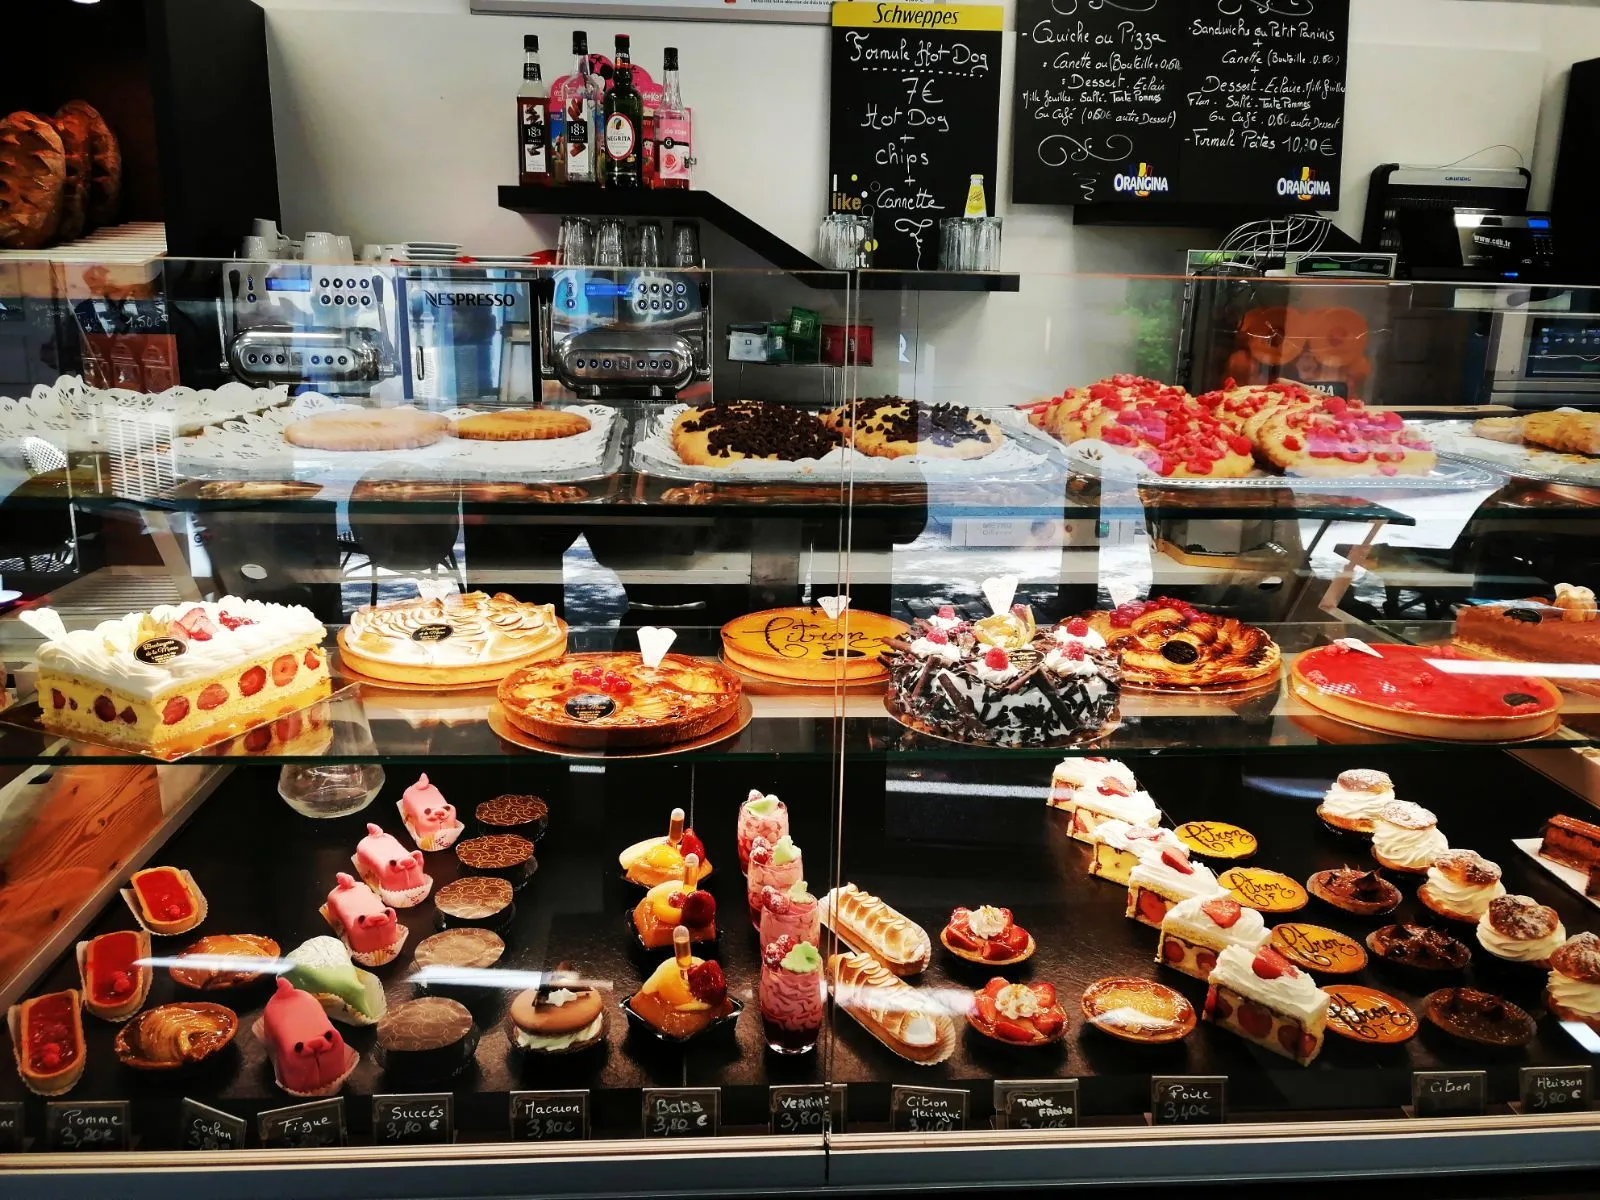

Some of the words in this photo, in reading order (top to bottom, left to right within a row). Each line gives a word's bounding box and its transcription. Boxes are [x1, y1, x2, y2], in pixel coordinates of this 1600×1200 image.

[873, 2, 959, 27] Schweppes
[1033, 19, 1089, 43] Quiche
[1095, 34, 1113, 44] ou
[1117, 21, 1166, 50] Pizza
[1268, 21, 1297, 37] Petit
[1298, 22, 1335, 42] Paninis
[845, 31, 910, 62] Formule
[914, 40, 950, 67] Hot
[951, 43, 989, 71] Dog
[861, 102, 903, 130] Hot
[907, 108, 949, 132] Dog
[1052, 107, 1077, 125] Café
[1192, 128, 1236, 147] Formule
[1114, 173, 1168, 192] ORANGINA
[1277, 177, 1331, 196] ORANGINA
[832, 192, 862, 211] like
[425, 289, 515, 307] NESPRESSO
[743, 616, 868, 658] Citron
[1168, 1085, 1213, 1099] Poire
[1430, 1080, 1471, 1093] Citron
[525, 1101, 580, 1118] Macaron
[656, 1099, 704, 1115] Baba
[906, 1096, 948, 1108] Citron
[63, 1109, 123, 1126] Pomme
[278, 1116, 332, 1134] Figue
[193, 1118, 232, 1141] Cochon
